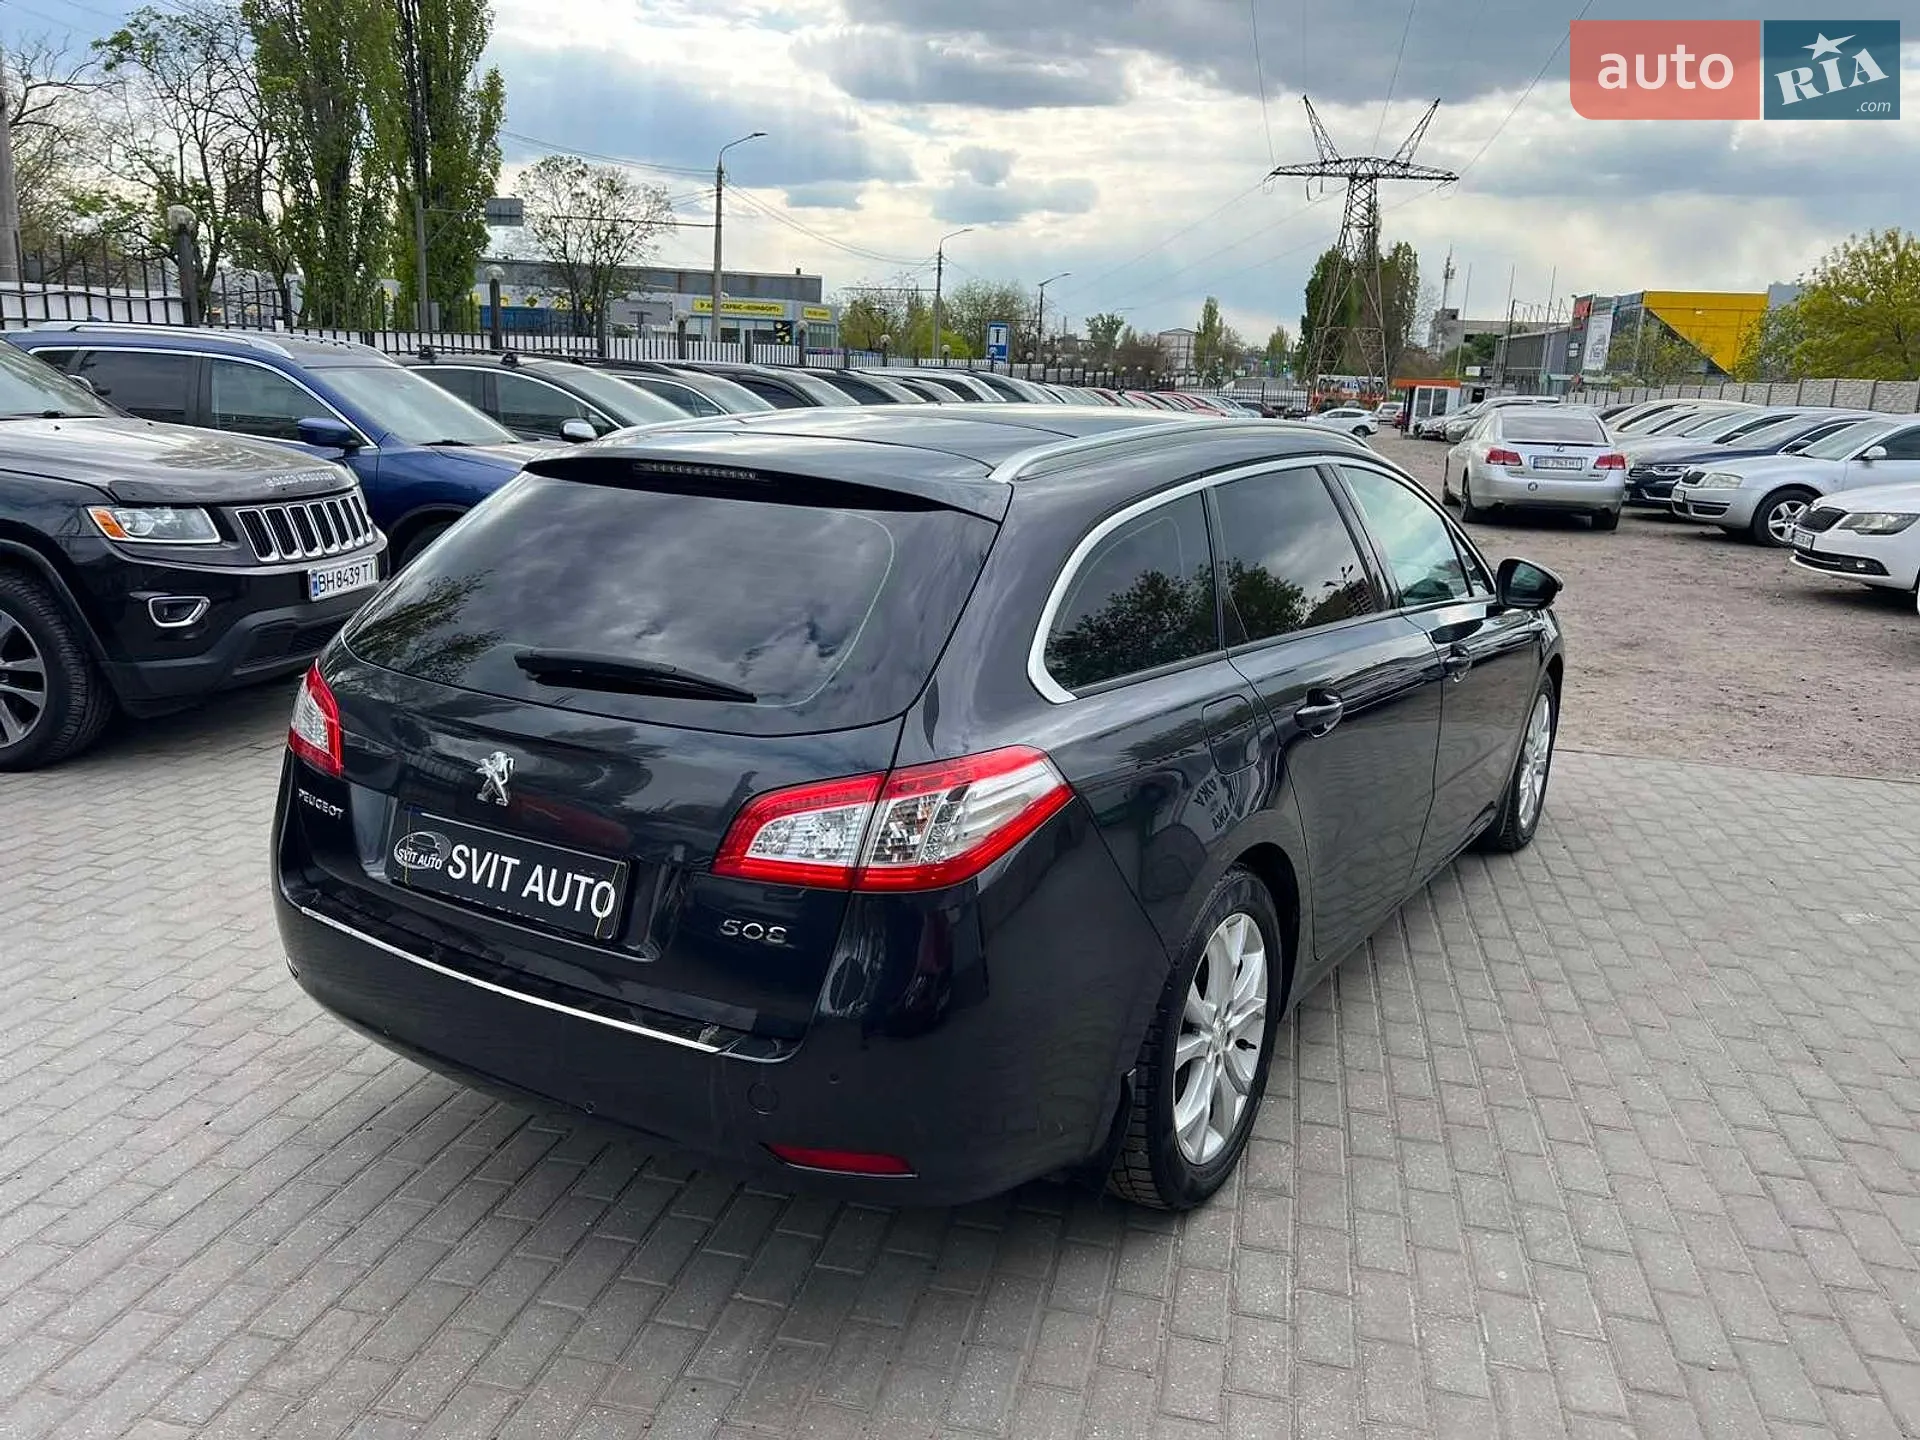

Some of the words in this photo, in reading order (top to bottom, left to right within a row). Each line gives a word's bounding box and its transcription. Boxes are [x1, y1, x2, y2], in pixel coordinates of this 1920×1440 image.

[336, 566, 360, 589] 8439
[298, 788, 344, 820] PEUGEOT
[398, 848, 419, 865] SVIT
[418, 855, 443, 871] AUTO
[448, 844, 520, 893] SVIT
[521, 864, 616, 919] AUTO
[720, 919, 787, 944] 508
